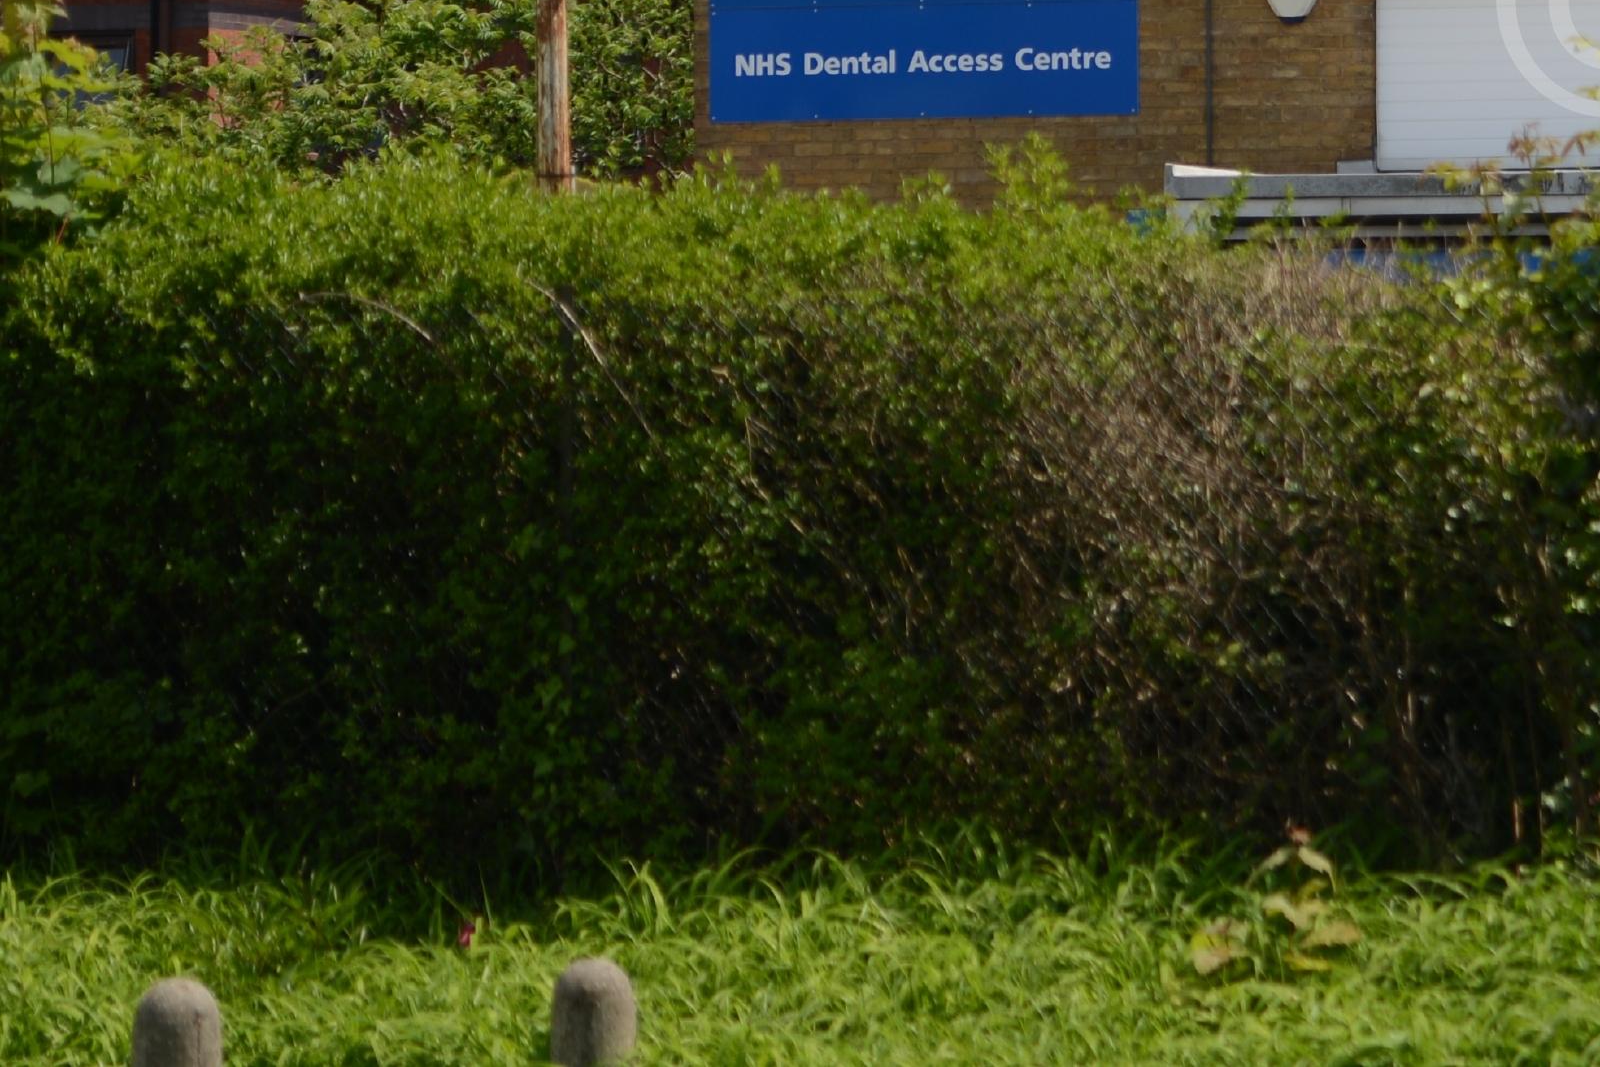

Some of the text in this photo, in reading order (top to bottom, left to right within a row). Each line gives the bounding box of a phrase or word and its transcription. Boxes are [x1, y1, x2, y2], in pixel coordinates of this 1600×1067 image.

[735, 46, 1112, 77] NHS Dental Access Centre
